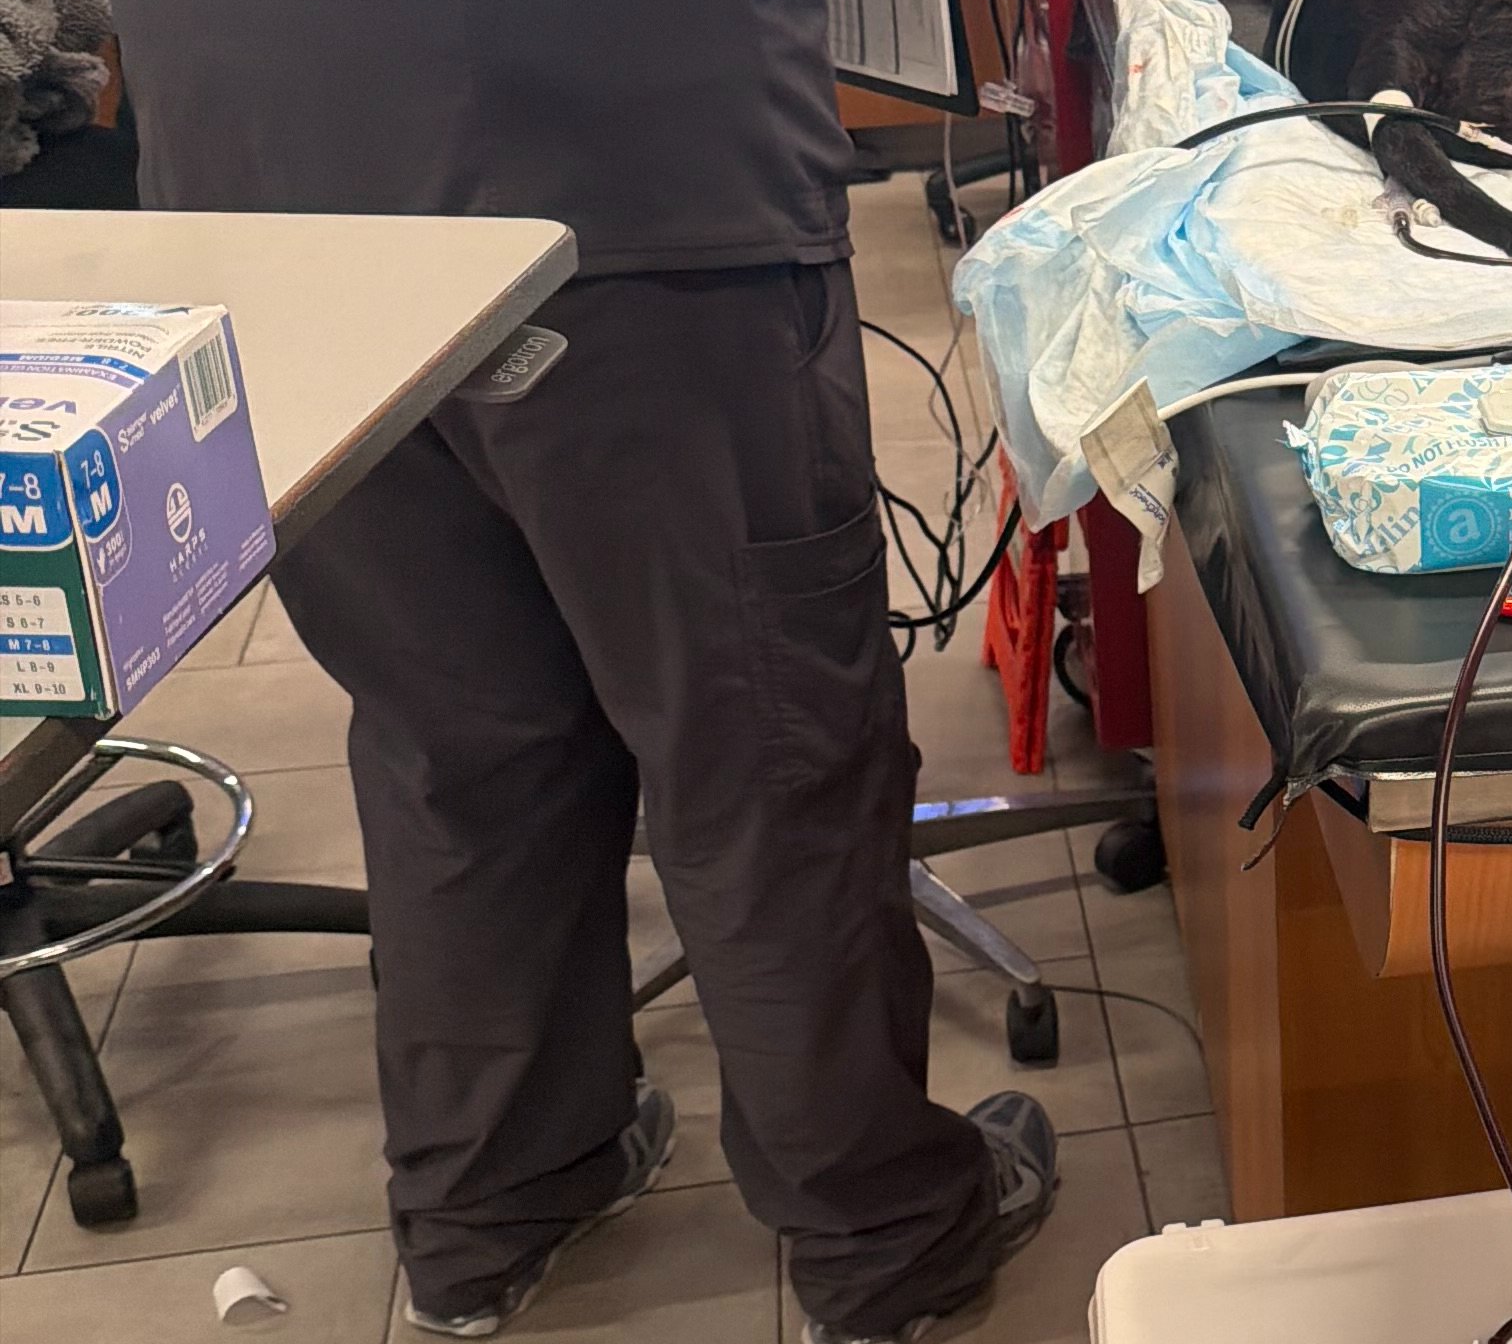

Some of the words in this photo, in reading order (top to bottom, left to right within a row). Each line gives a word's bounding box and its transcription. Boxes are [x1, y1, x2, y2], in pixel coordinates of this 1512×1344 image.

[84, 344, 145, 359] NITRILE
[490, 336, 551, 383] ergotron
[1411, 443, 1445, 470] NOT
[90, 482, 113, 522] M
[0, 506, 48, 534] M
[1447, 508, 1481, 544] a
[169, 527, 207, 573] HARPS
[16, 595, 41, 607] 5-6
[7, 617, 15, 629] S
[20, 617, 44, 629] 6-7
[8, 639, 20, 651] M
[25, 639, 51, 651] 7-8
[17, 662, 25, 673] L
[30, 661, 55, 673] 8-9
[13, 683, 29, 694] XL
[35, 683, 66, 695] 9-10
